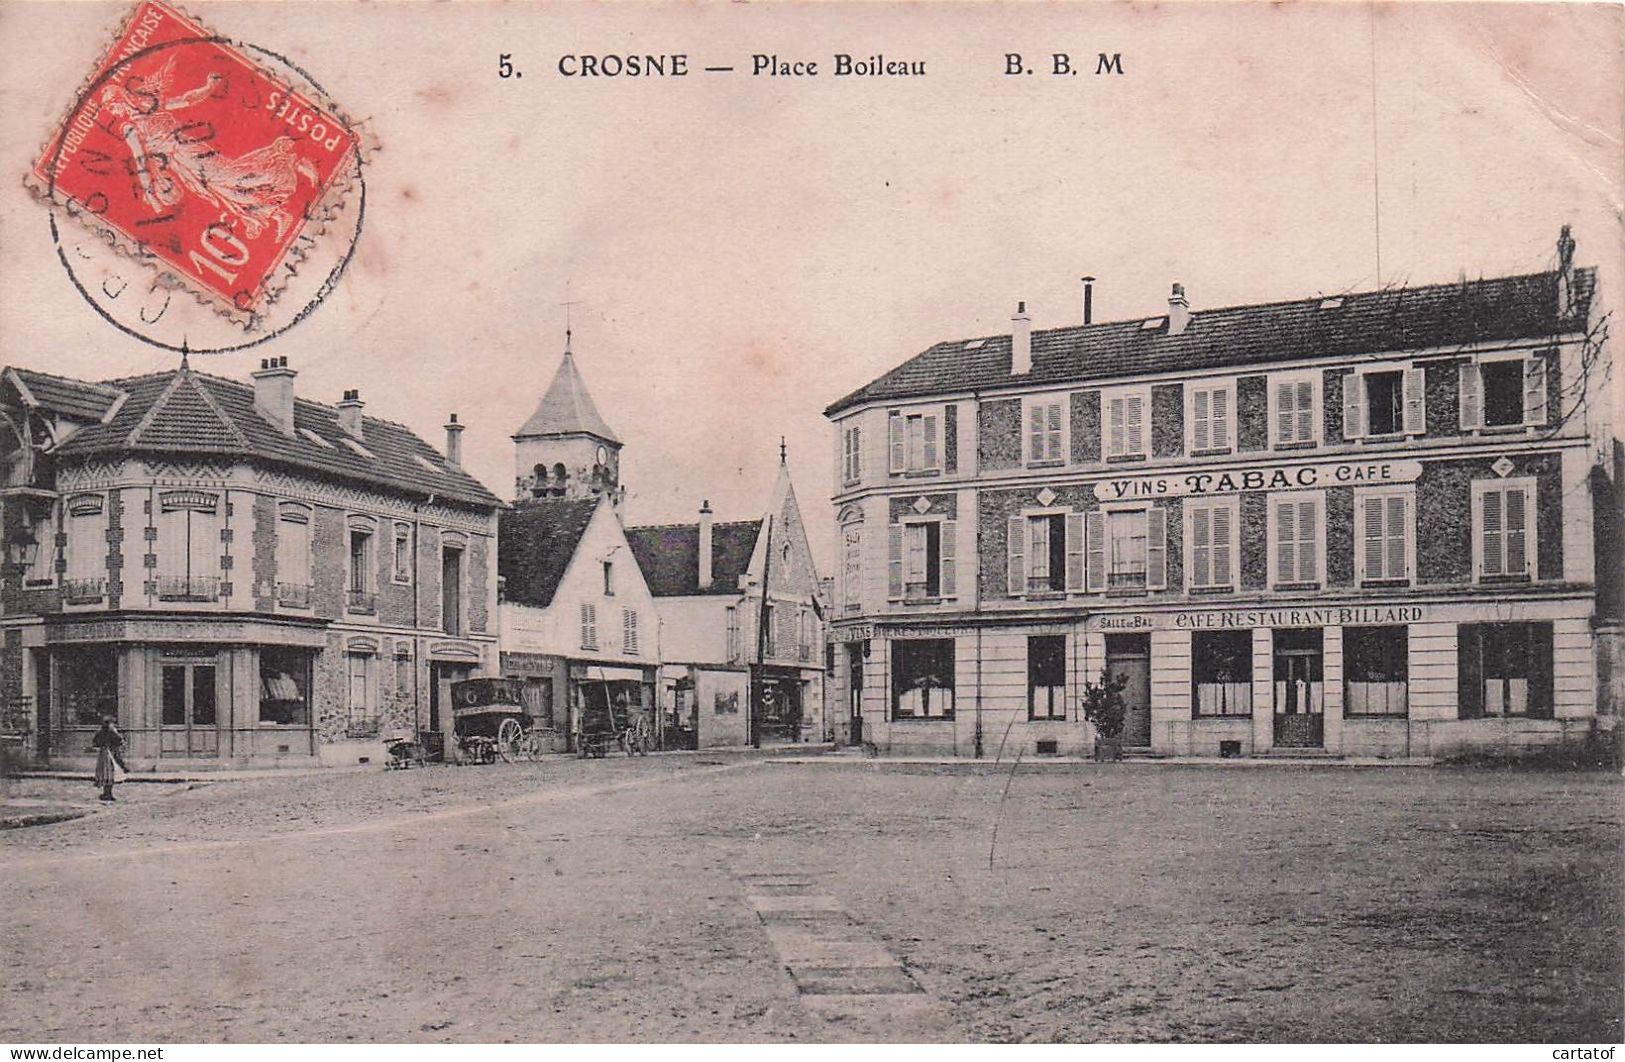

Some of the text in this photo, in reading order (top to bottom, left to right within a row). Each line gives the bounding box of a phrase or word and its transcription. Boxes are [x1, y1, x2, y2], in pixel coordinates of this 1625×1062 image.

[498, 53, 1124, 79] 5. CROSNE Place Boileau B. B. M
[266, 92, 341, 151] POSTES
[1111, 464, 1391, 498] VINS TABAC CAFE
[1100, 617, 1126, 629] SALLE
[1134, 615, 1153, 628] BAL
[1176, 607, 1422, 628] CAFE RESTAURANT BILLARD
